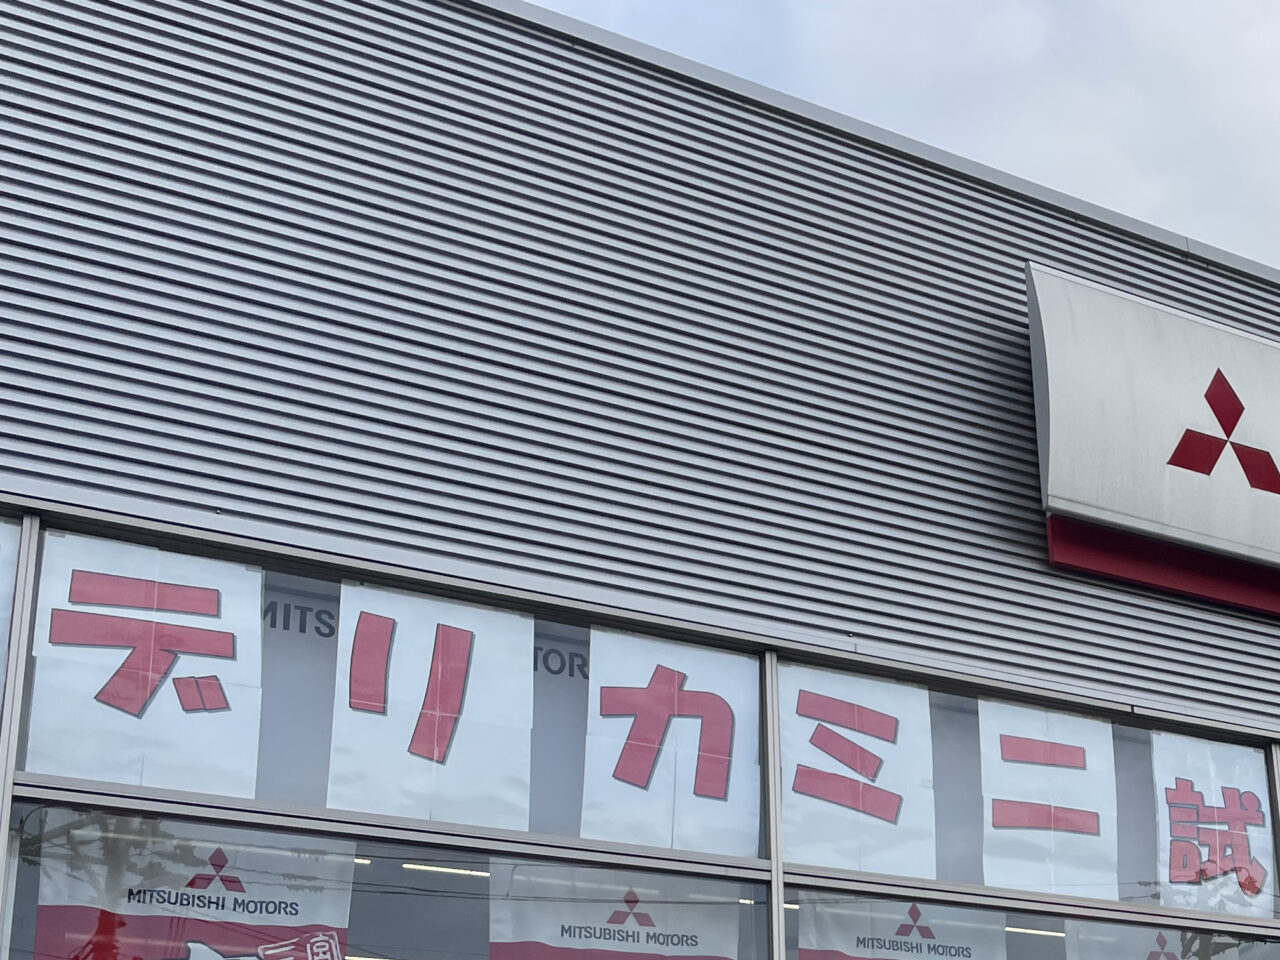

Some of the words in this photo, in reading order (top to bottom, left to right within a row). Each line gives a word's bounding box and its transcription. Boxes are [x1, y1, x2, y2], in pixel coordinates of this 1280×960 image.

[128, 889, 225, 910] MITSUBISHI
[233, 898, 299, 915] MOTORS
[560, 925, 640, 944] MITSUBISHI
[646, 932, 699, 947] MOTORS
[856, 936, 923, 954] MITSUBISHI
[927, 943, 972, 958] MOTORS
